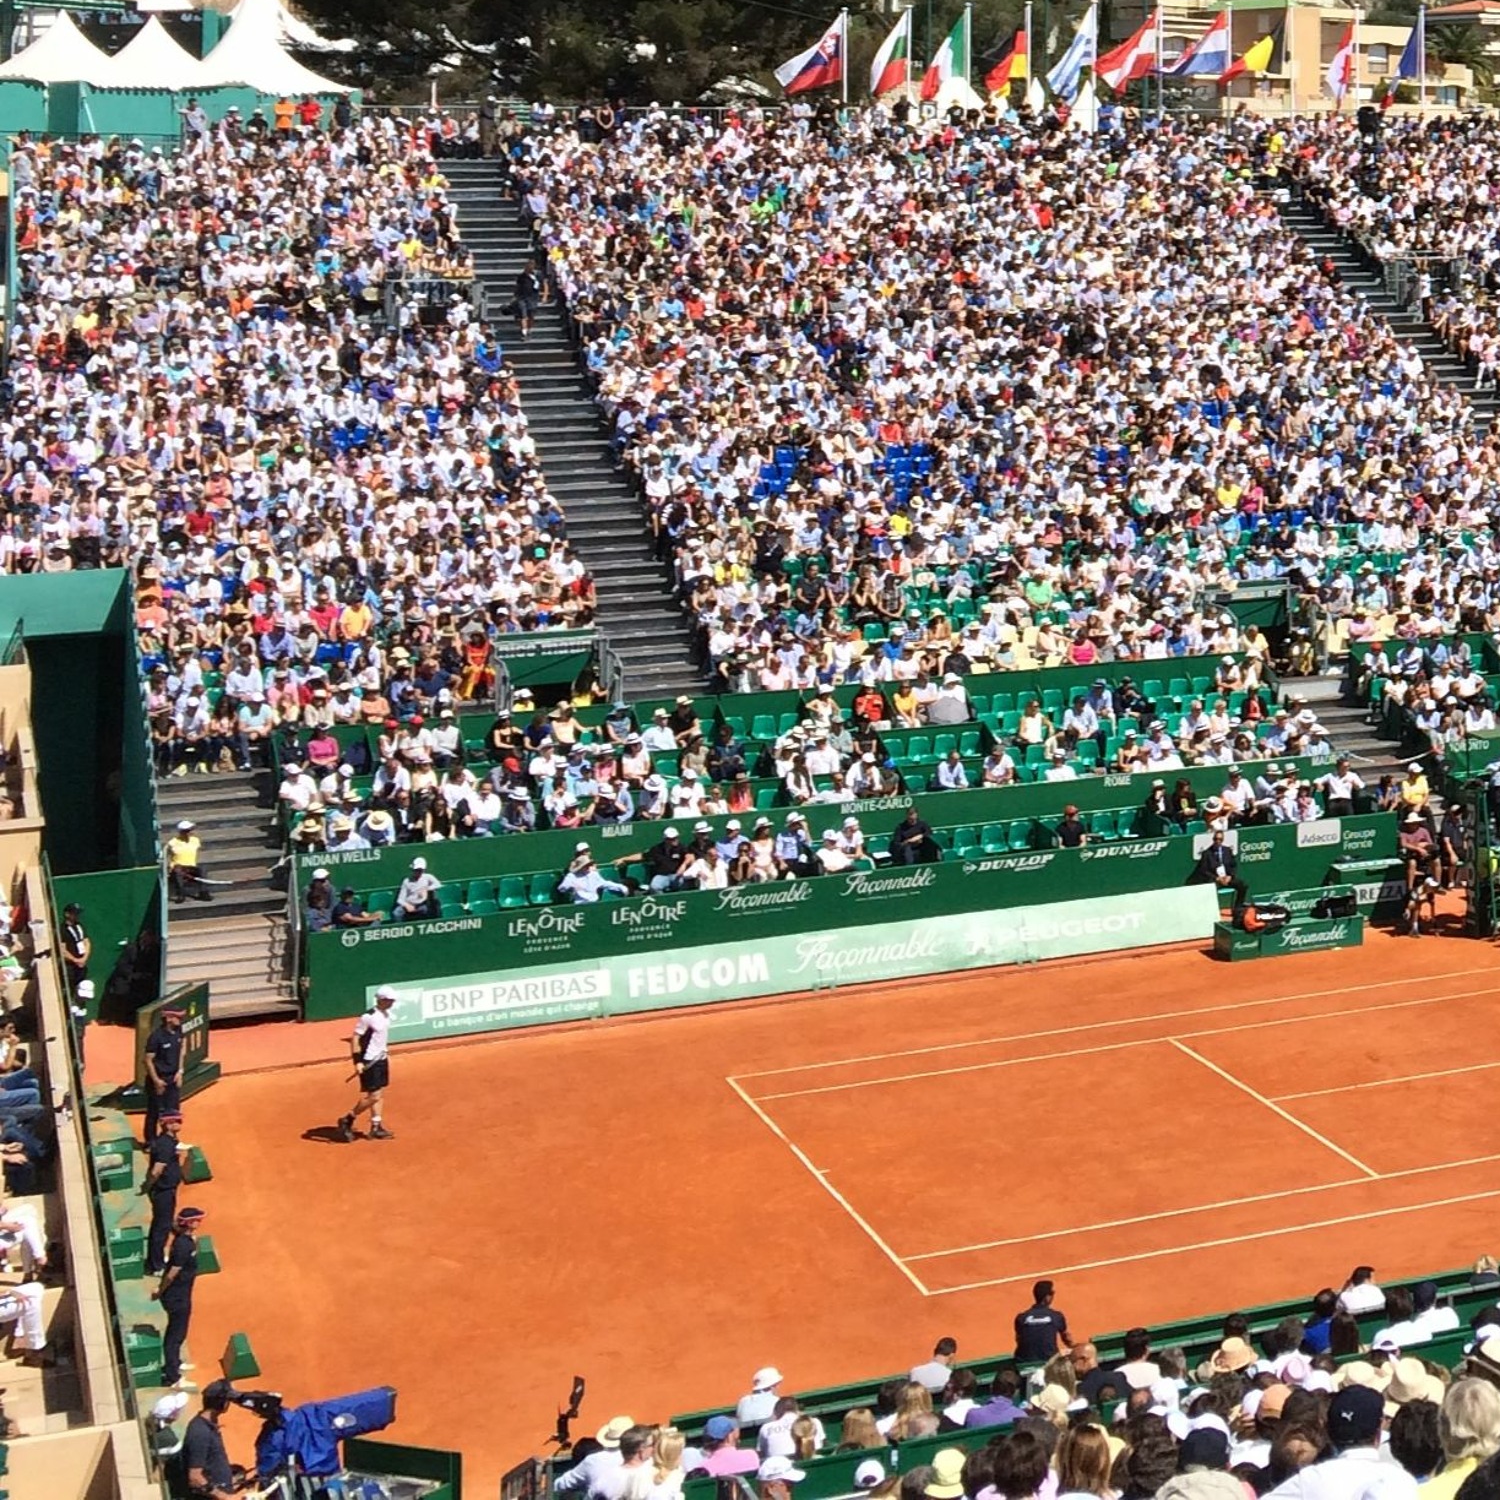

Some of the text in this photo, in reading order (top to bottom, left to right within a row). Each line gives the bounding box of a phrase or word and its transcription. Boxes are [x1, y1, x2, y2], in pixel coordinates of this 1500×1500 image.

[1103, 775, 1132, 787] ROME
[840, 797, 913, 814] MONTE-CARLO
[601, 824, 633, 838] MIAMI
[1300, 832, 1338, 845] Adecco
[1342, 828, 1377, 841] Groupe
[1091, 841, 1169, 859] DUNLOP
[1240, 840, 1275, 853] Groupe
[1342, 838, 1373, 850] France
[301, 848, 382, 868] INDIAN WELLS
[976, 853, 1055, 872] DUNLOP
[1240, 851, 1272, 863] France
[840, 867, 937, 897] Façonnable
[713, 881, 813, 911] Façonnable
[363, 918, 483, 942] SERGIO TACCHINI
[995, 912, 1145, 943] PEUGEOT
[787, 928, 947, 973] Façonnable
[628, 953, 769, 998] FEDCOM
[432, 975, 598, 1013] BNP PARIBAS
[447, 1015, 485, 1028] banque
[510, 1008, 545, 1019] monde
[564, 1000, 600, 1012] change
